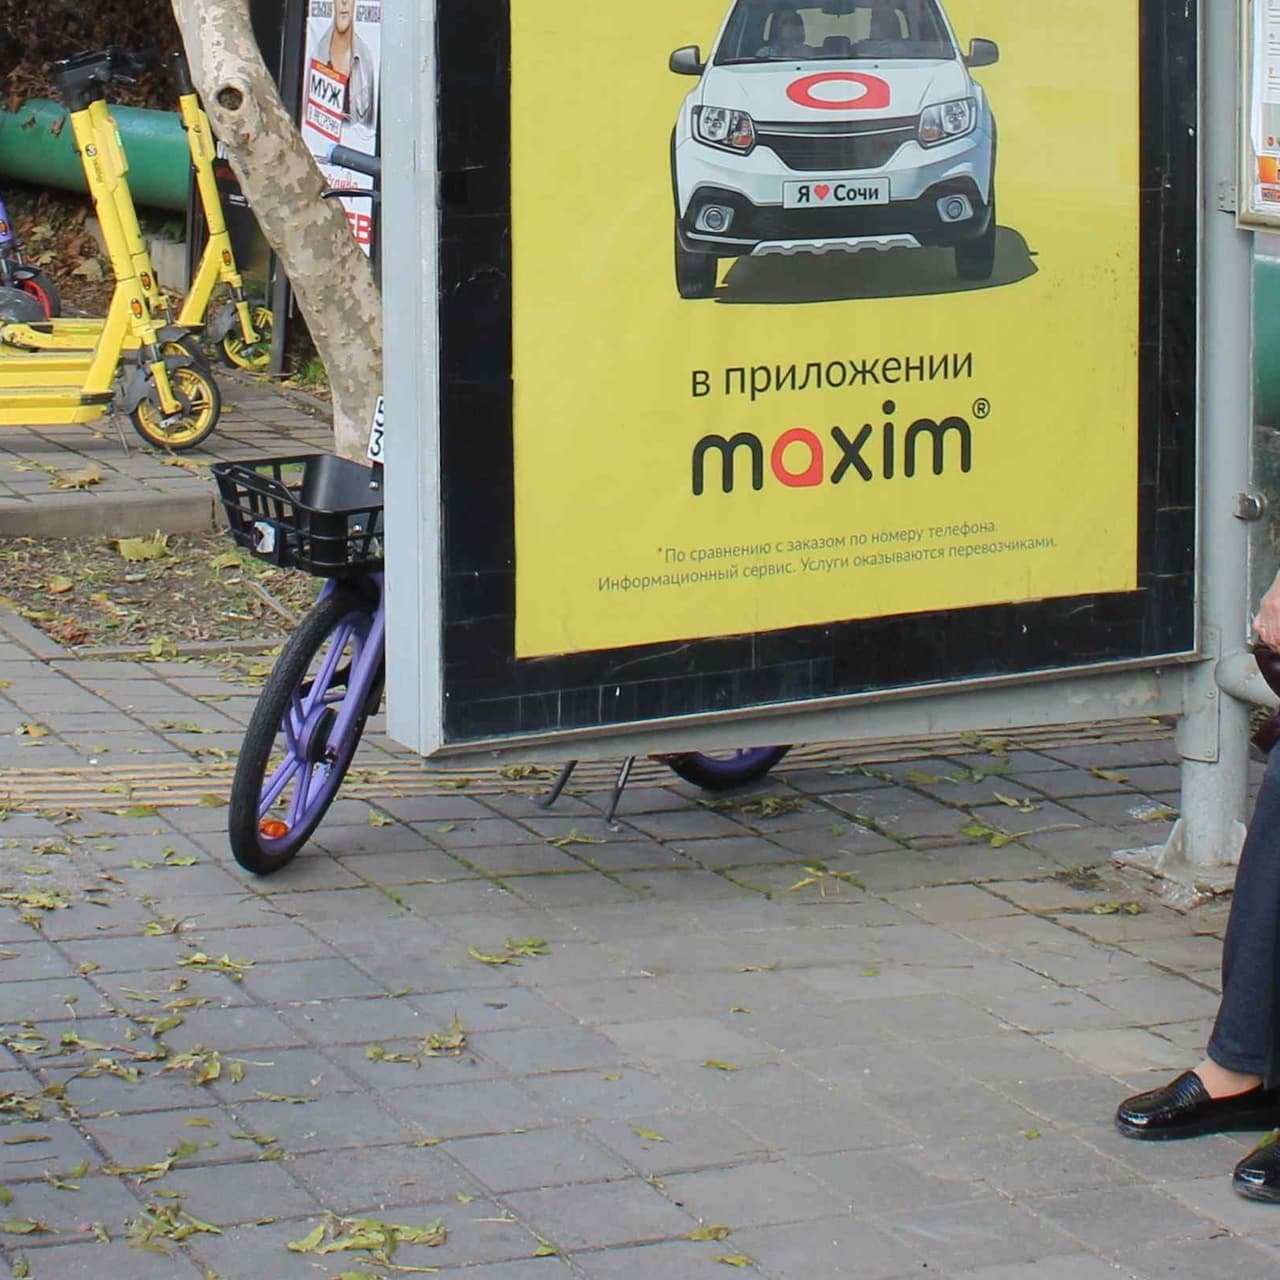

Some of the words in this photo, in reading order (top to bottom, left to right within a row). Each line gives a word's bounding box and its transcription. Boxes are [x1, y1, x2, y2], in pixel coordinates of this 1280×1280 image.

[311, 74, 342, 109] МУЖ
[796, 185, 811, 203] Я
[833, 183, 879, 202] Сочи
[691, 369, 711, 397] в
[724, 351, 974, 401] приложении
[690, 541, 772, 563] сравнению
[775, 540, 784, 553] с
[786, 534, 846, 552] заказом
[849, 532, 868, 546] по
[871, 527, 924, 544] номеру
[927, 520, 999, 540] телефона.
[598, 563, 739, 592] Информационный
[742, 559, 797, 580] сервис.
[800, 556, 850, 573] Услуги
[852, 546, 945, 568] оказываются
[948, 535, 1058, 559] перевозчиками.
